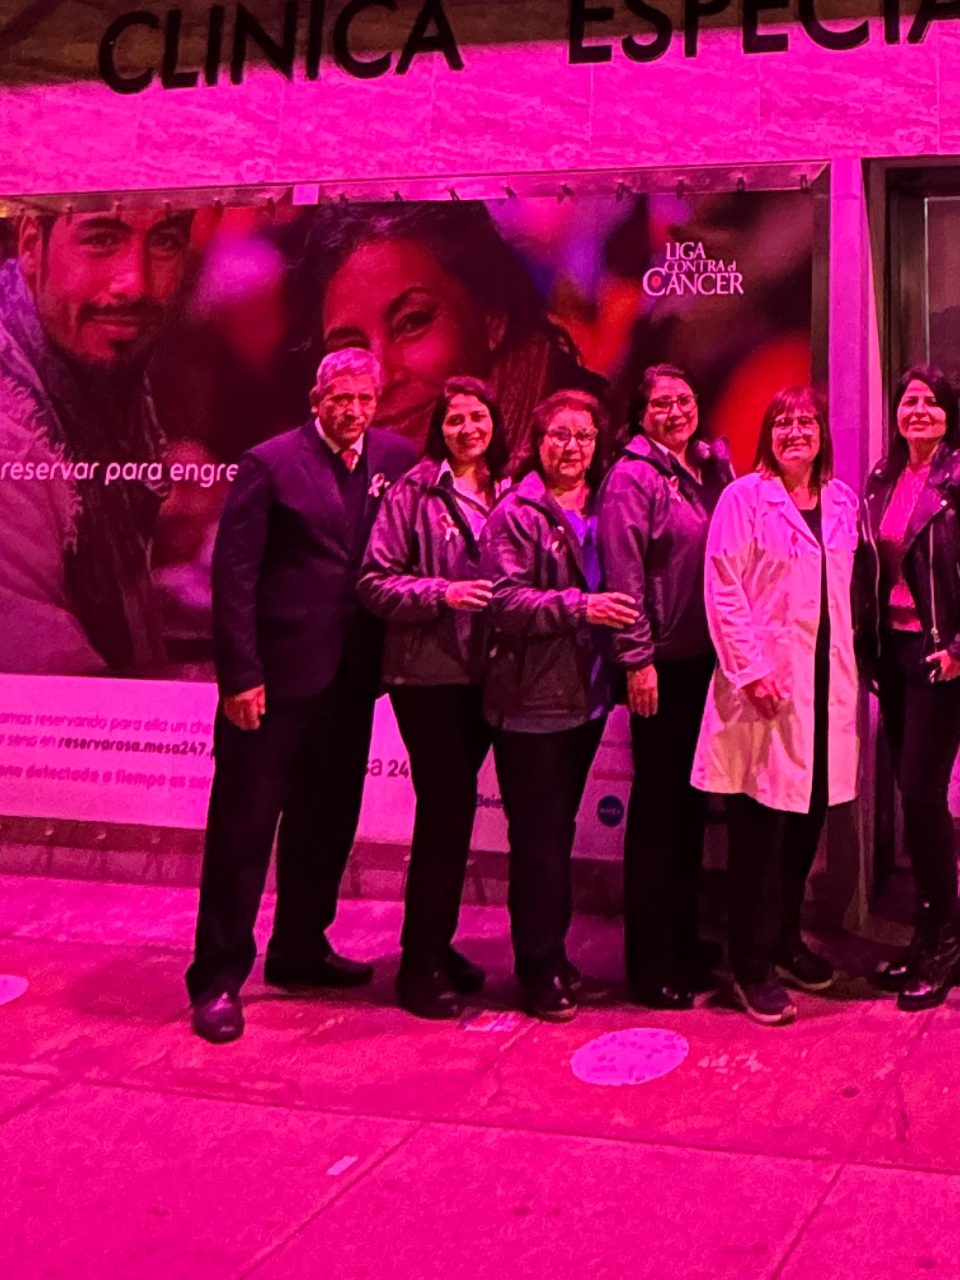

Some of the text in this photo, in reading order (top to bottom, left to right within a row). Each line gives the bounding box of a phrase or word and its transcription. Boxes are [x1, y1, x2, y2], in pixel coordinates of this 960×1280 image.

[665, 241, 706, 260] LIGA
[664, 259, 725, 273] CONTRA
[0, 462, 99, 481] reservar
[104, 462, 163, 486] para
